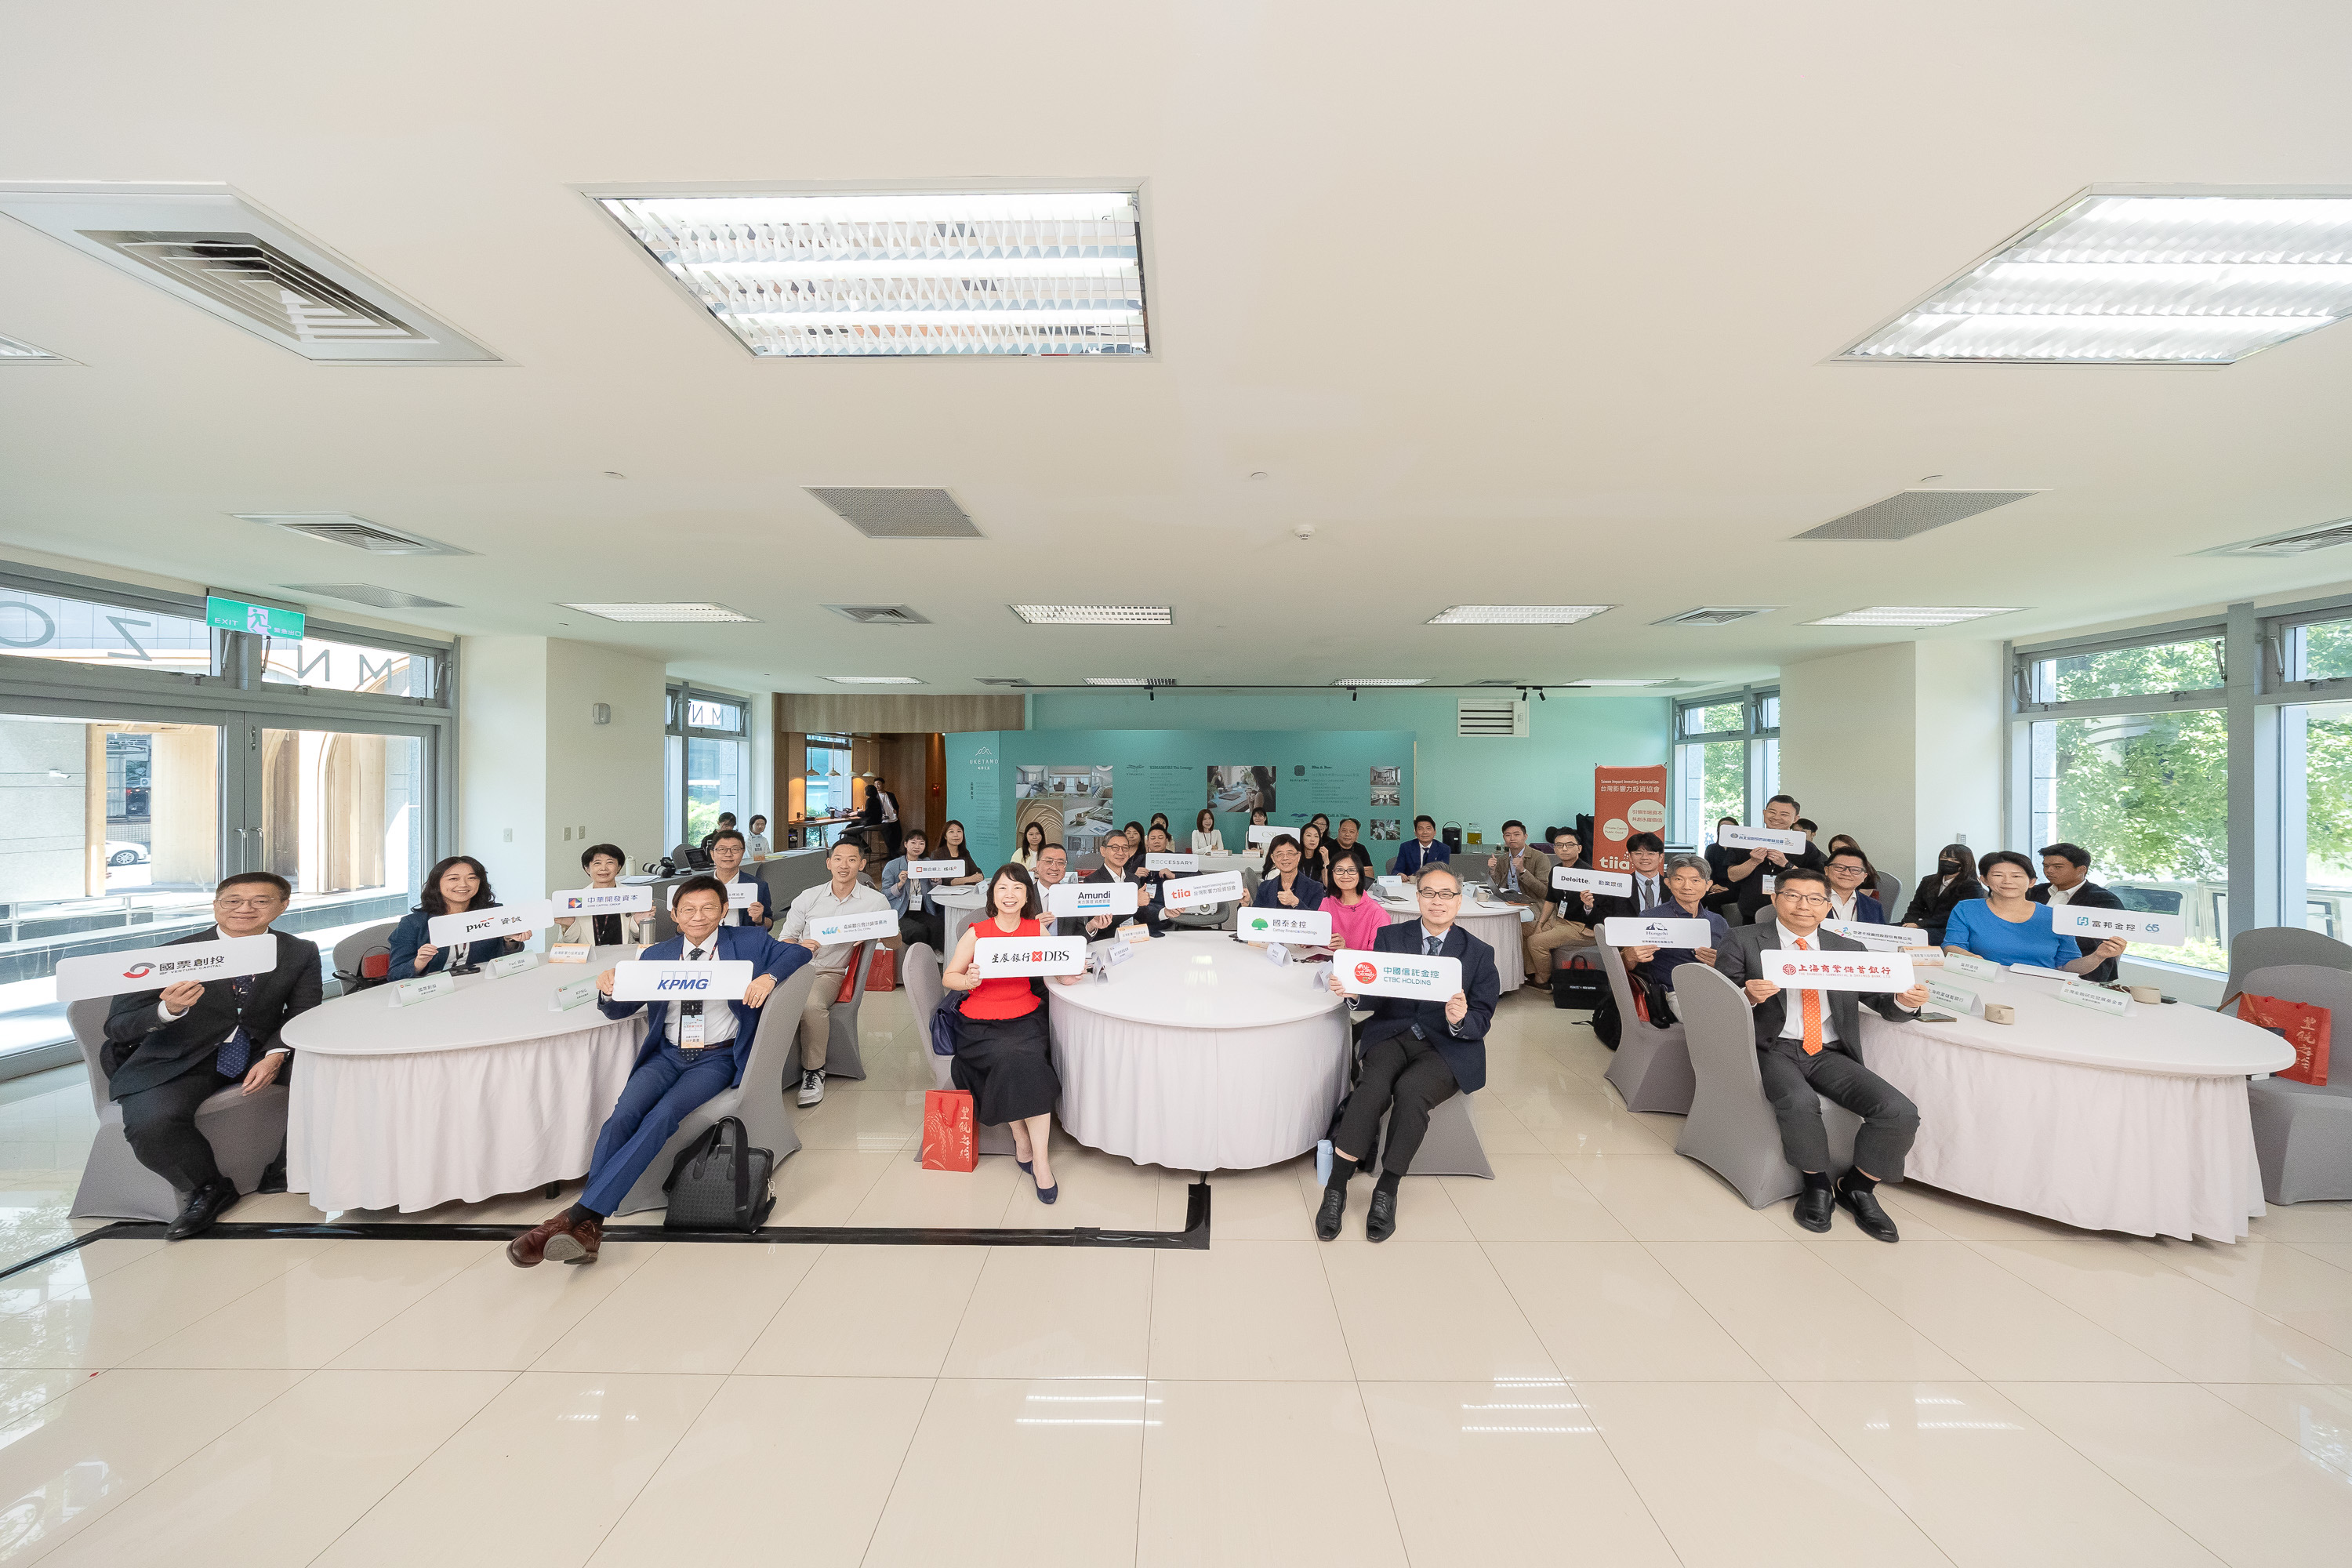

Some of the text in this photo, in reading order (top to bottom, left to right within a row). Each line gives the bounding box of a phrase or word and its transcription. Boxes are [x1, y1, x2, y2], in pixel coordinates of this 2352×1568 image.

[214, 617, 238, 626] EXIT
[273, 626, 303, 637] 緊急出口
[1600, 785, 1661, 793] 台灣影響力投資協會
[1599, 855, 1630, 870] tiia
[1560, 875, 1591, 884] Deloitte.
[1077, 891, 1111, 899] Amundi
[1171, 888, 1191, 899] tiia
[1193, 885, 1236, 896] 台灣影響力投資協會
[586, 894, 639, 904] 中華開發資本
[500, 916, 522, 925] 資誠
[1272, 919, 1307, 929] 國泰金控
[2092, 920, 2136, 931] 富邦金控
[991, 953, 1031, 964] 星展銀行
[1044, 950, 1070, 962] DBS
[159, 956, 225, 972] 國票創投
[1798, 964, 1892, 975] 上海商業儲蓄銀行
[1383, 967, 1439, 978] 中國信託金控
[656, 978, 709, 990] KPMG
